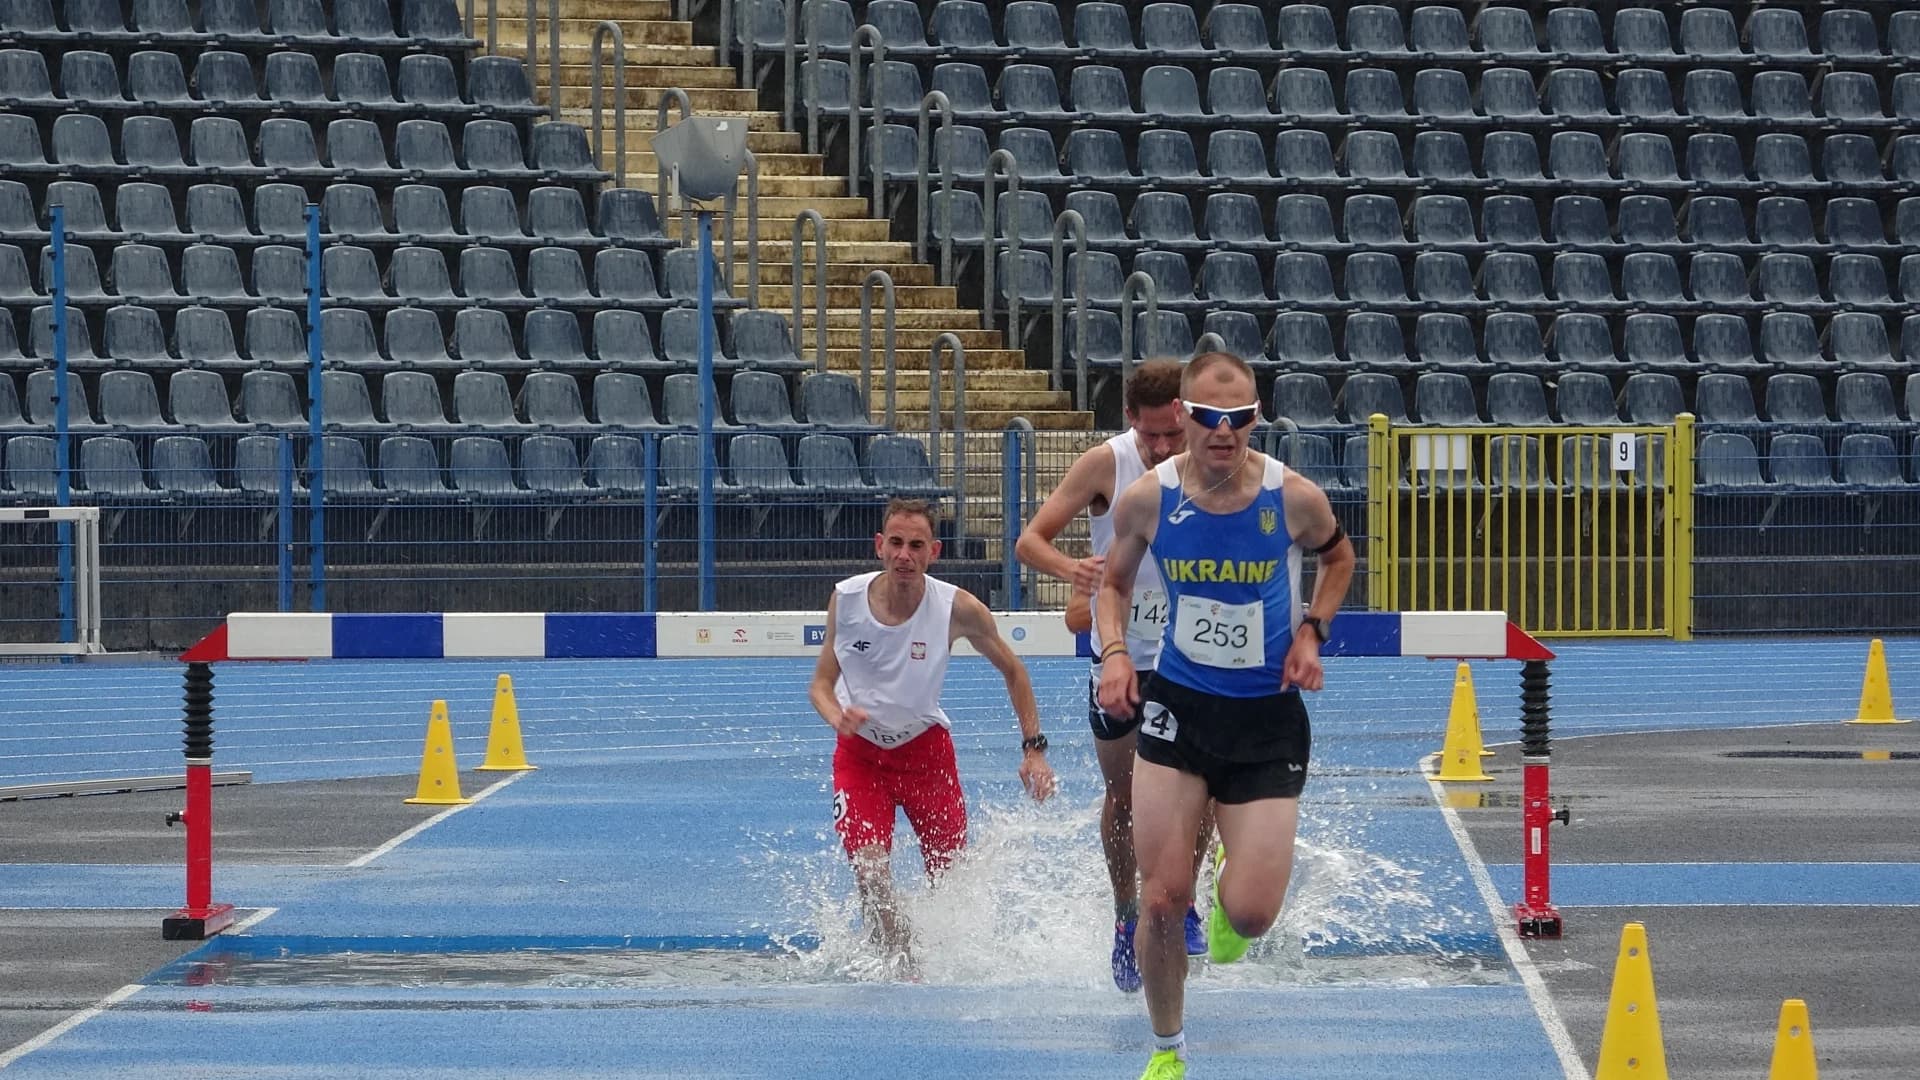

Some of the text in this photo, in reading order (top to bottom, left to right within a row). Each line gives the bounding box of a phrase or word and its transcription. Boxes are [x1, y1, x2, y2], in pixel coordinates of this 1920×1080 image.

[1620, 441, 1628, 461] 9
[1163, 557, 1279, 583] UKRAINE
[811, 630, 826, 640] BY
[852, 640, 871, 651] 4F
[1193, 618, 1248, 648] 253
[1151, 709, 1170, 736] 4
[833, 793, 841, 820] 5
